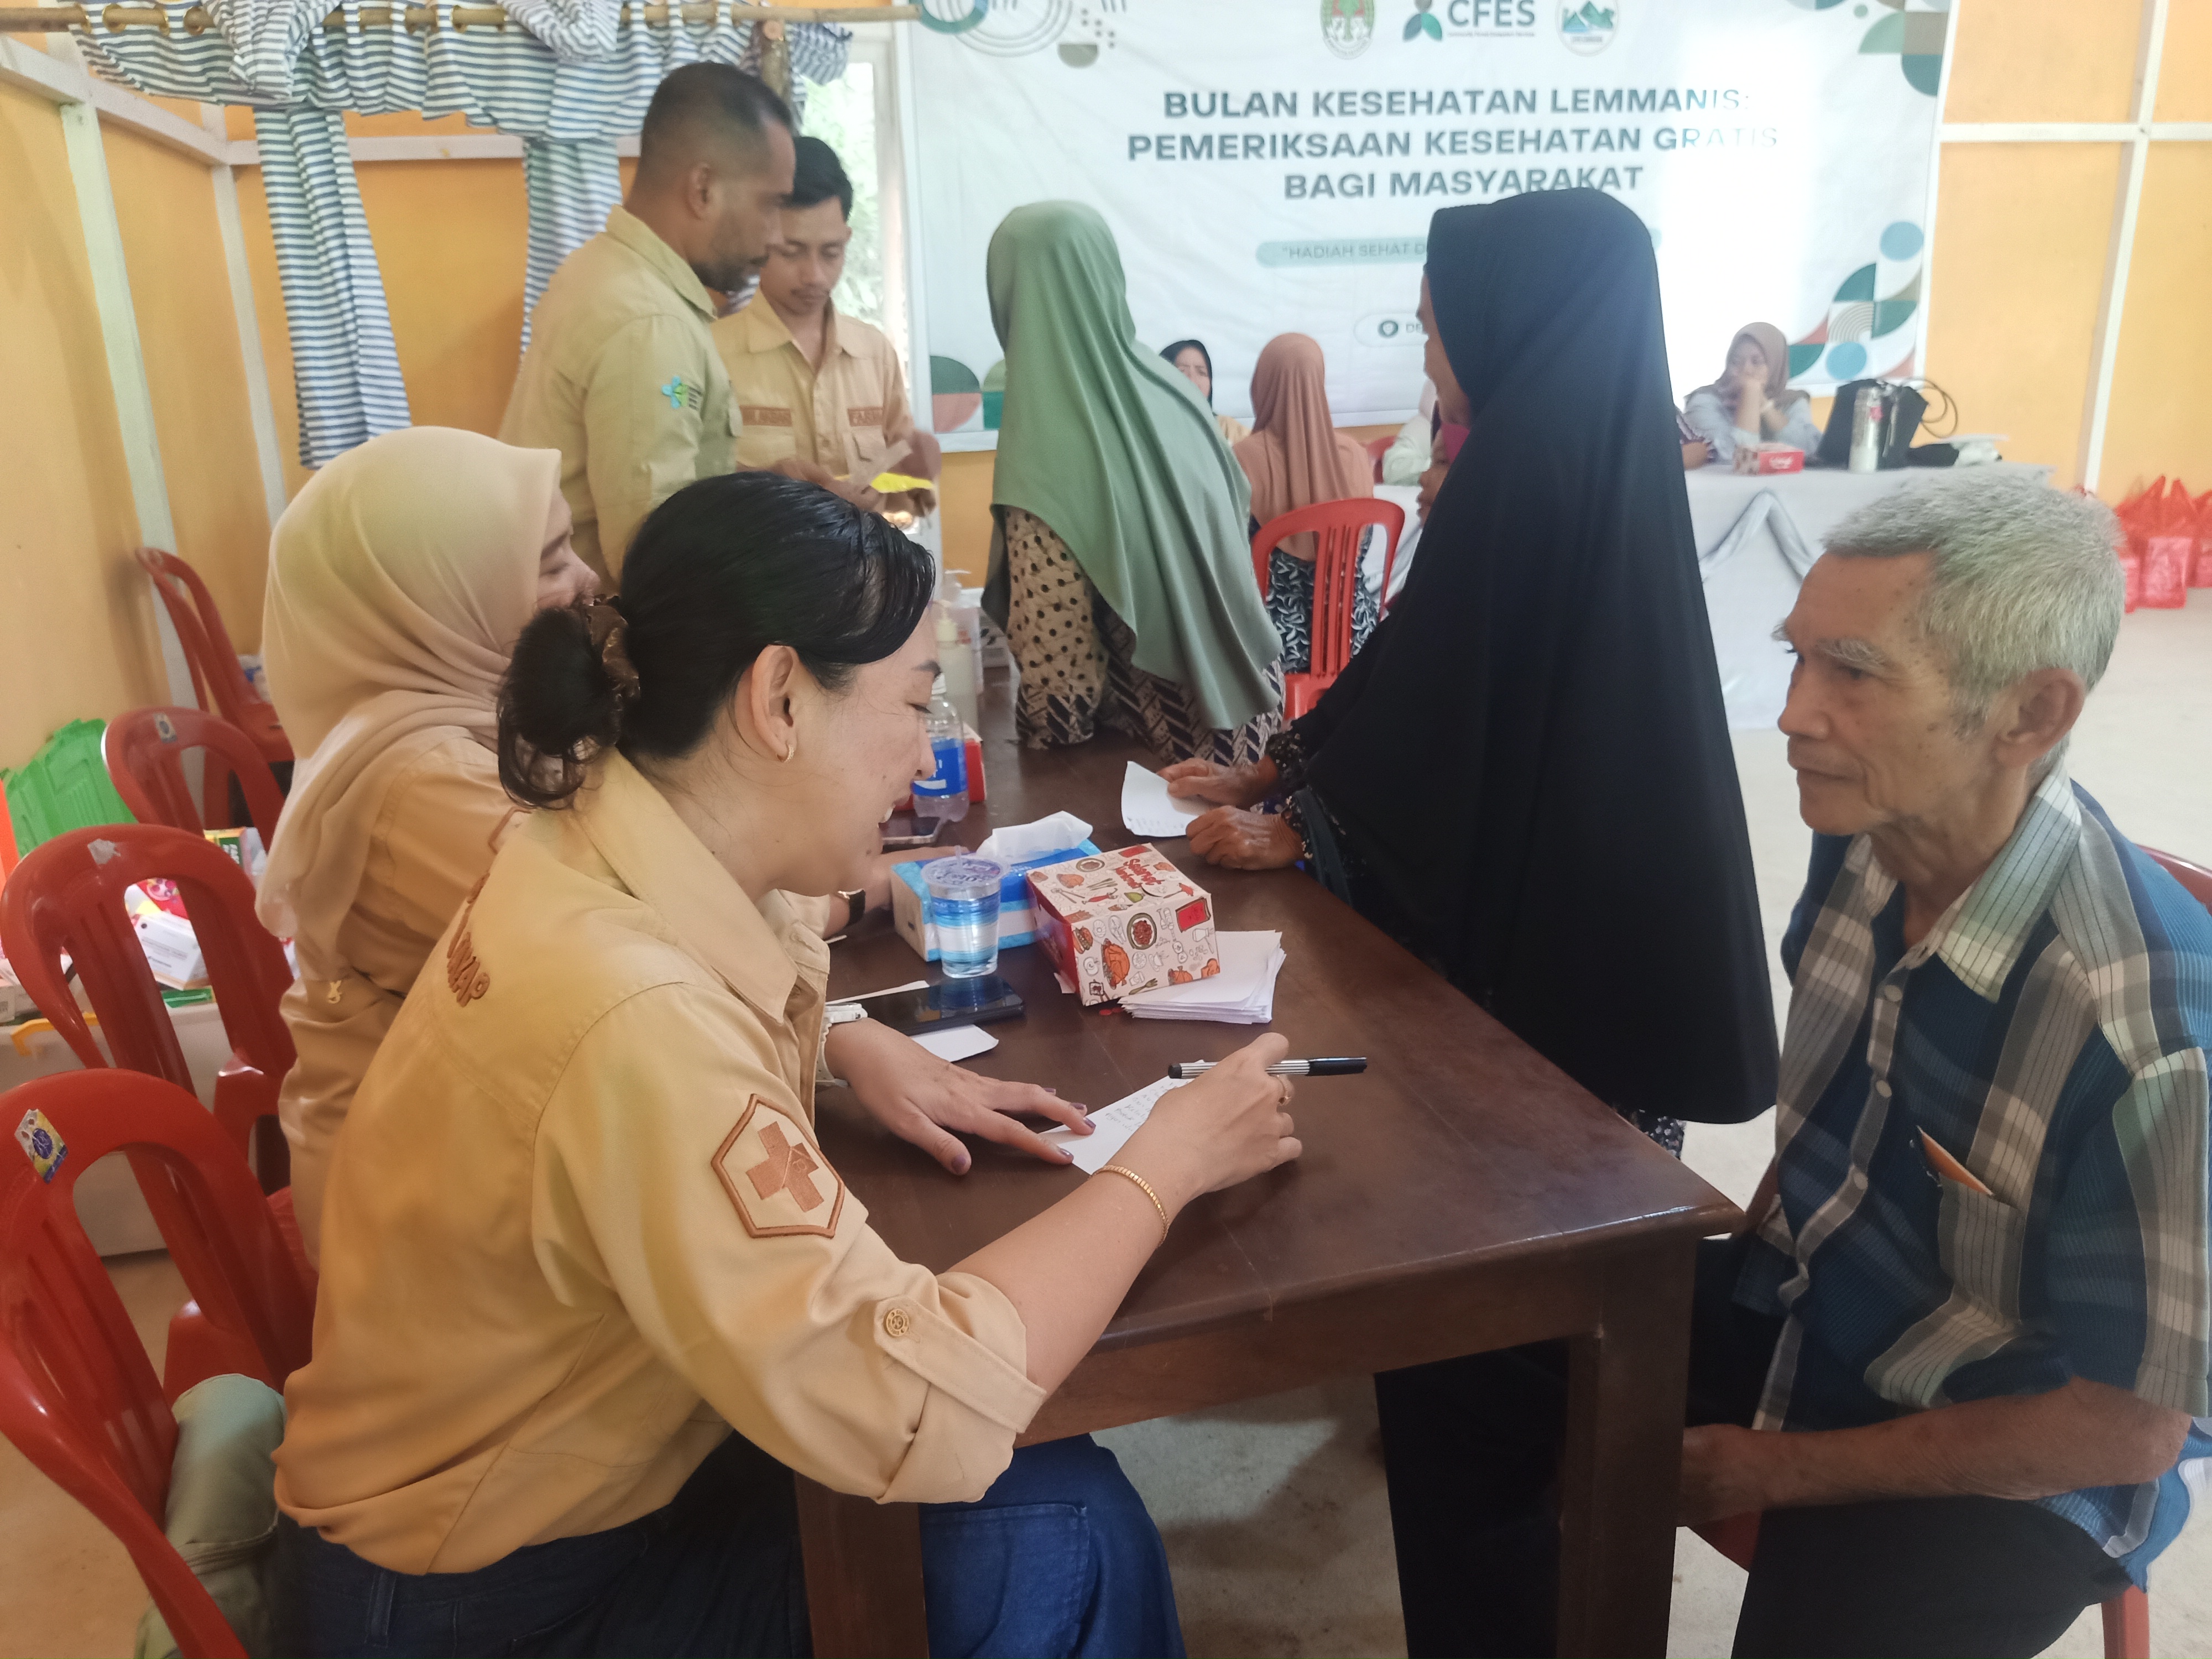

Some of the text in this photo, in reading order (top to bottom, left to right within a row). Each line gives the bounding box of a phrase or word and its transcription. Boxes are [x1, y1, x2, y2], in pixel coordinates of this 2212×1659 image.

[1447, 0, 1536, 27] CFES
[1164, 91, 1298, 118] BULAN
[1312, 88, 1537, 117] KESEHATAN
[1128, 126, 1777, 161] PEMERIKSAAN KESEHATAN GRATIS
[1284, 166, 1644, 200] BAGI MASYARAKAT
[1358, 243, 1409, 257] SEHAT
